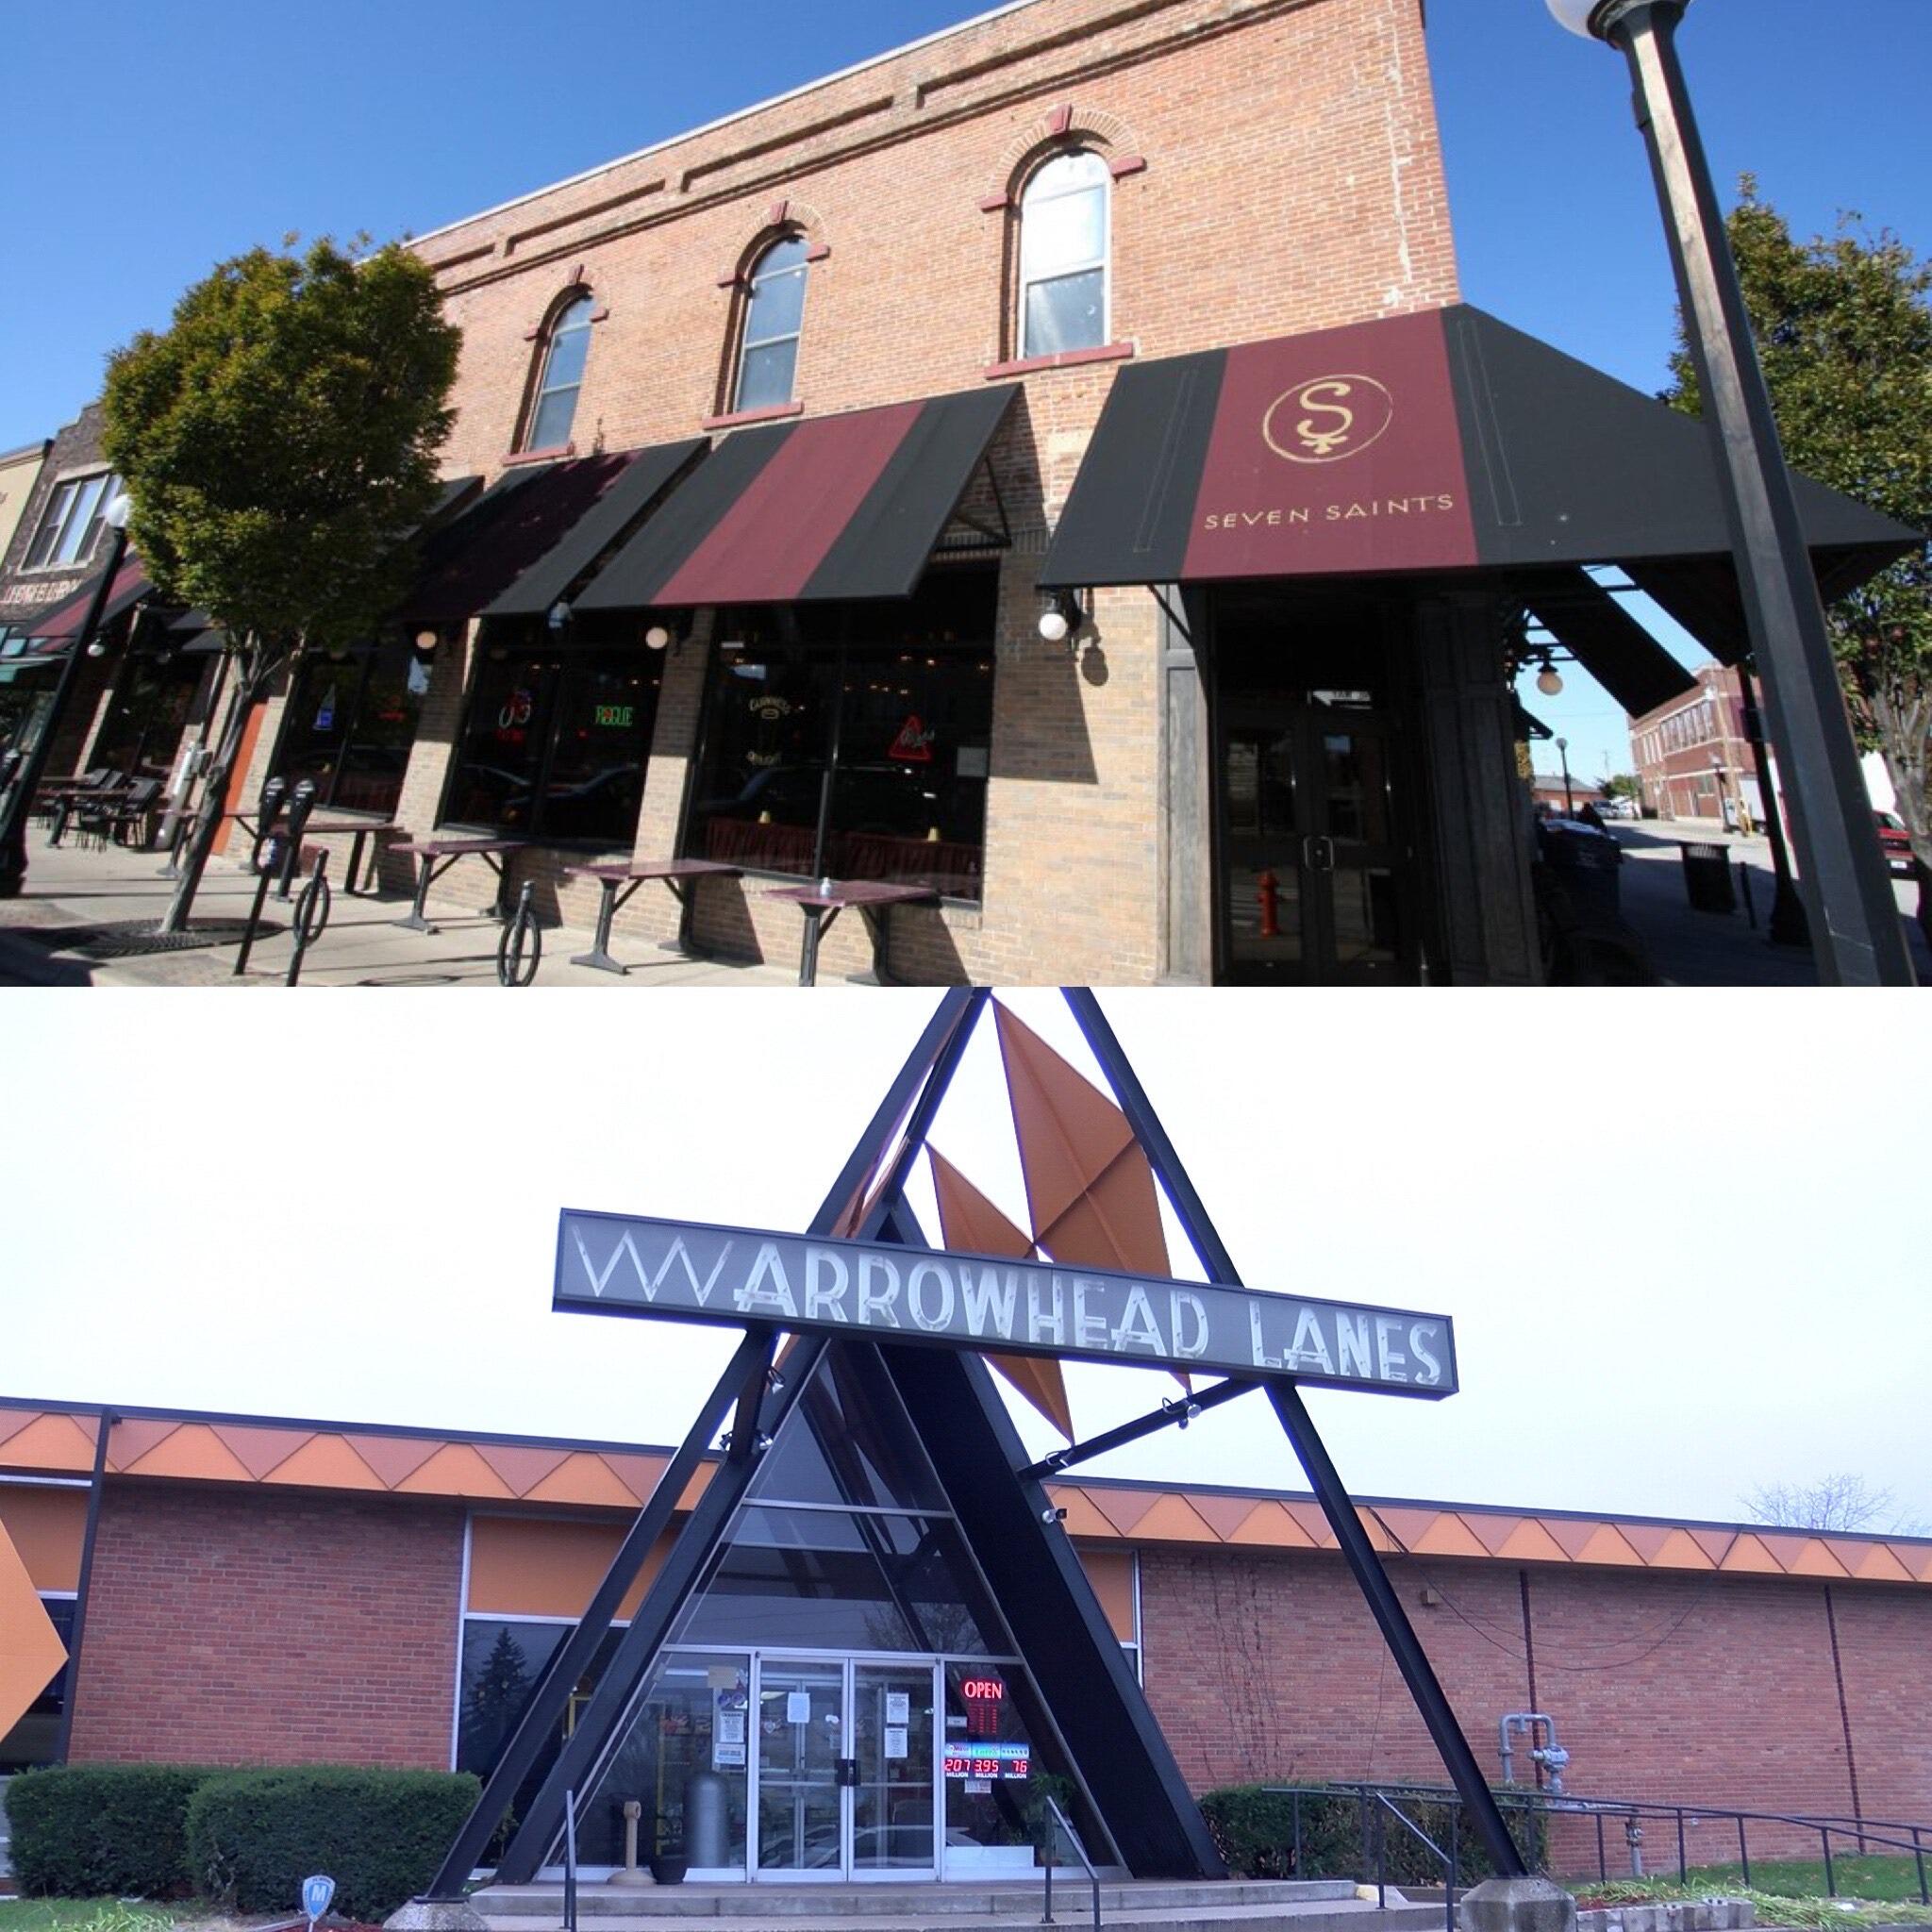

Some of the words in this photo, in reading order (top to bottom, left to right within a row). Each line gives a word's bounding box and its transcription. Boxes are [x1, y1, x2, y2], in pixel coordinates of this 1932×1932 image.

[1204, 508, 1310, 530] SEVEN
[1324, 492, 1455, 521] SAINTS
[1248, 1299, 1442, 1387] LANES
[964, 1681, 1002, 1699] OPEN
[944, 1759, 971, 1773] 207
[1012, 1760, 1027, 1773] 76
